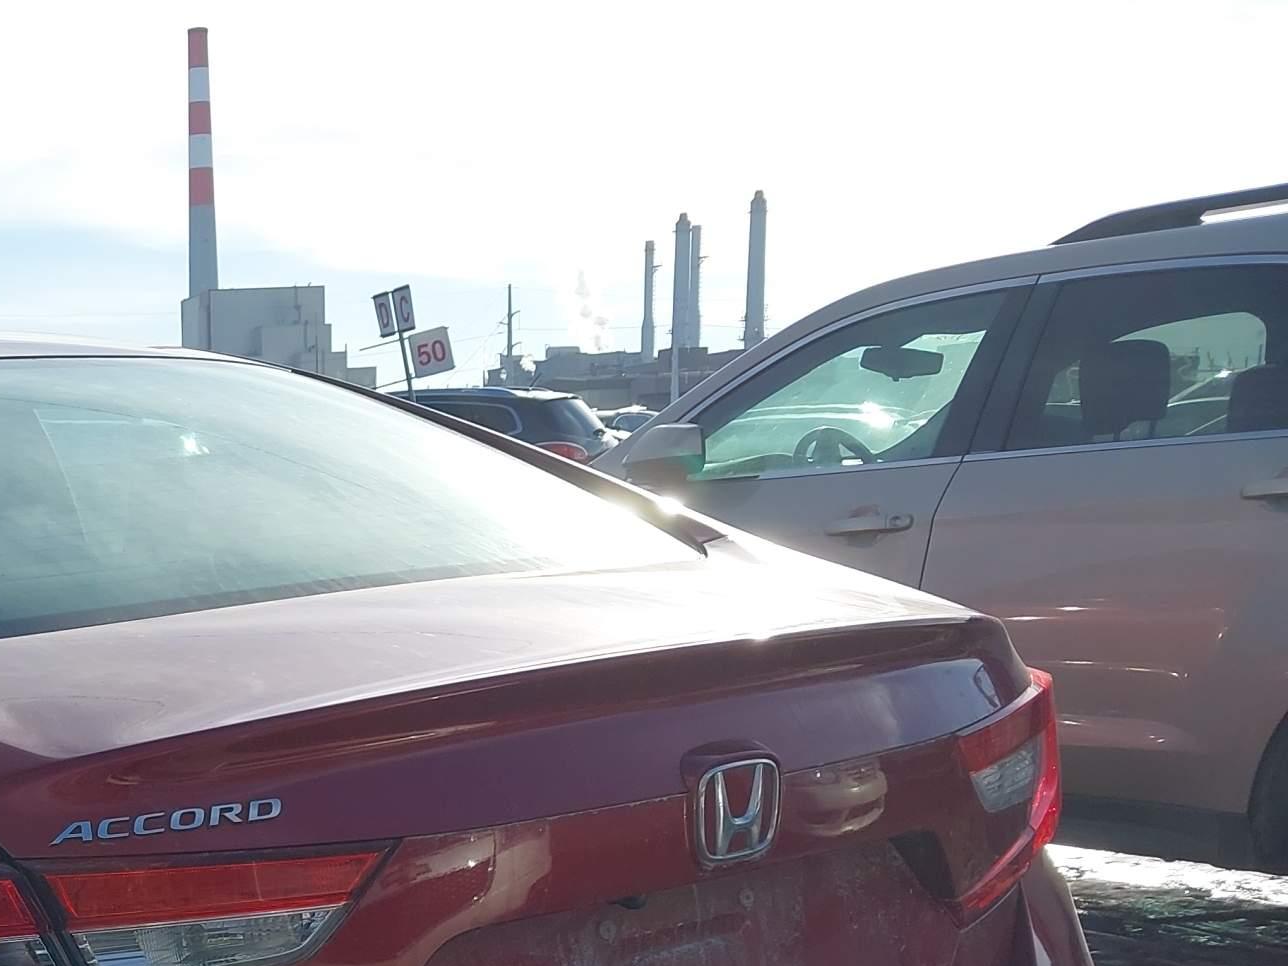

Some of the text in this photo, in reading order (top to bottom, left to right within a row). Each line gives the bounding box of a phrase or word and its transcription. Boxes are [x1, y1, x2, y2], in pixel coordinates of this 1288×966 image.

[399, 296, 410, 323] C
[417, 340, 446, 366] 50
[48, 797, 282, 847] ACCORD
